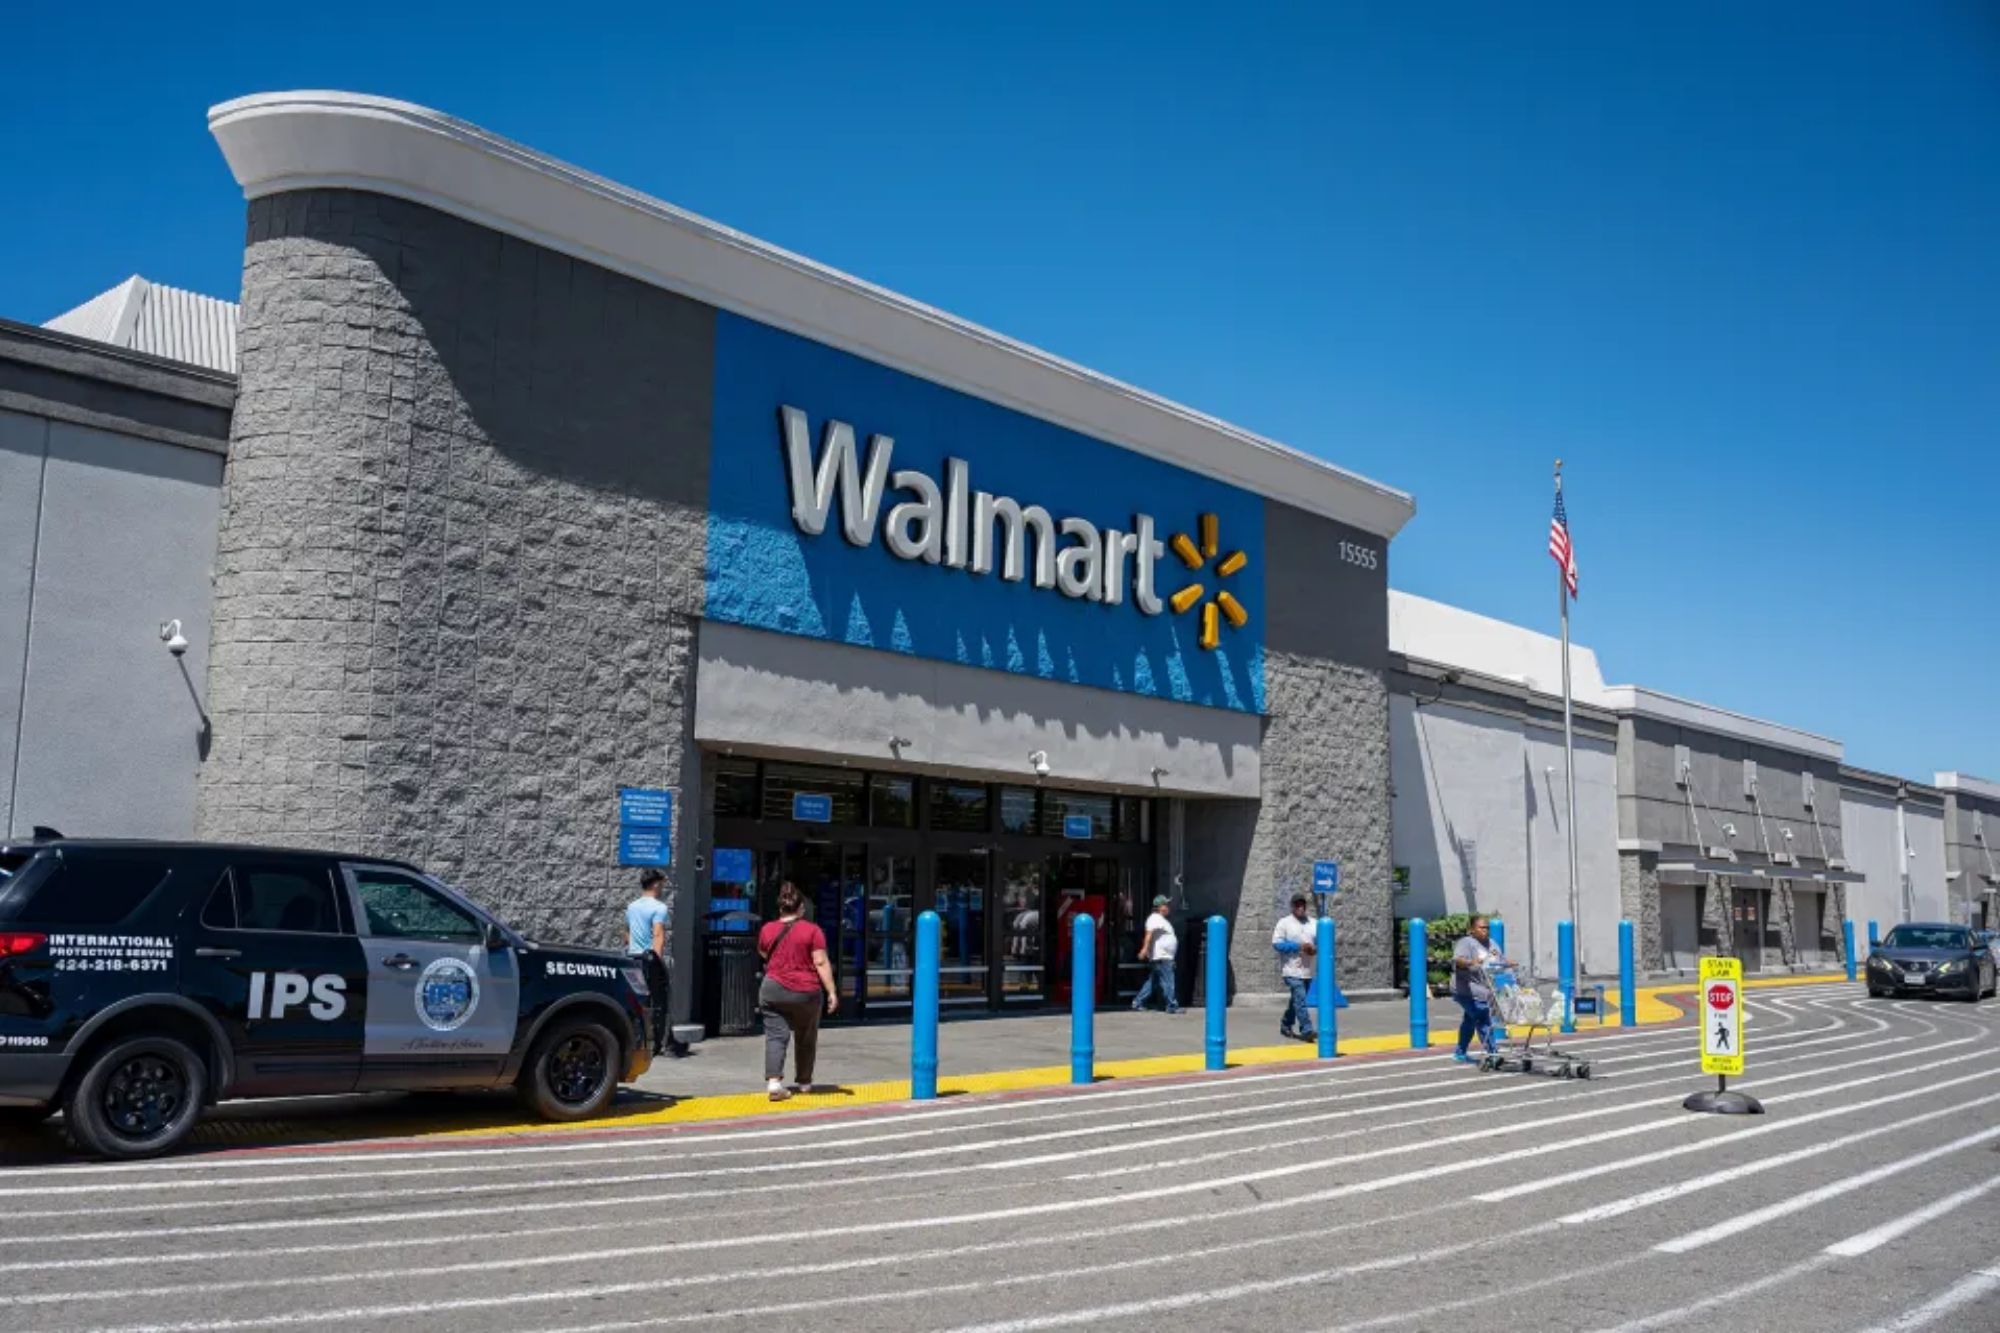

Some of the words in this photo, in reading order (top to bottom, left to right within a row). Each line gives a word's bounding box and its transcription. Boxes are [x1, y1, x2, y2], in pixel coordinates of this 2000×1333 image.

[779, 404, 1164, 615] Walmart
[1338, 541, 1378, 570] 15555
[49, 934, 173, 948] INTERNATIONAL
[49, 947, 124, 957] PROTECTIVE
[56, 959, 167, 971] 424-218-6371
[546, 960, 616, 979] SECURITY
[1707, 959, 1733, 969] STATE
[247, 972, 347, 1021] IPS
[1710, 992, 1733, 1003] STOP
